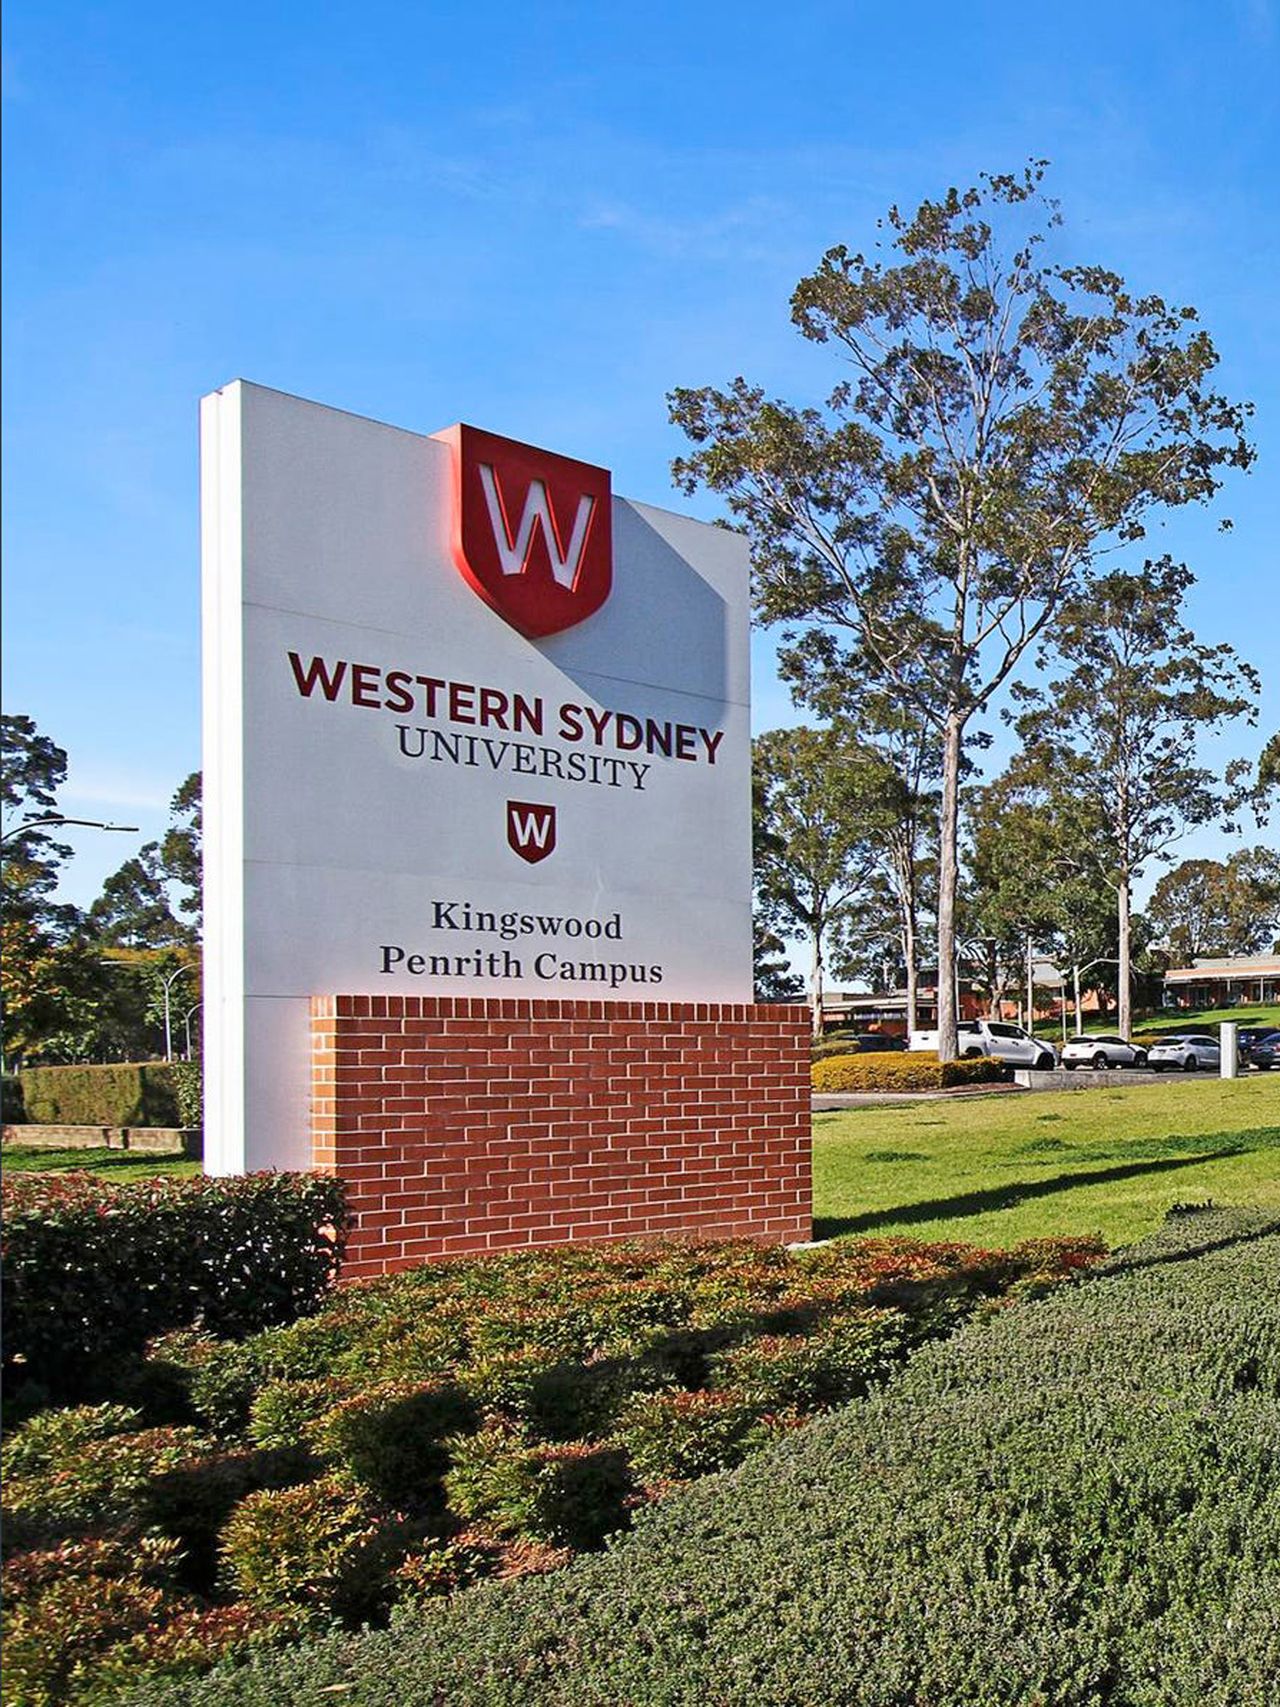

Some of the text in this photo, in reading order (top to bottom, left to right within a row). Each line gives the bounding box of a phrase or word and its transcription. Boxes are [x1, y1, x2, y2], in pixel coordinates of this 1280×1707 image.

[480, 464, 597, 592] W
[288, 652, 723, 764] WESTERN SYDNEY
[396, 725, 651, 790] UNIVERSITY
[511, 811, 552, 848] W
[431, 901, 623, 941] Kingswood
[379, 945, 664, 988] Penrith Campus
